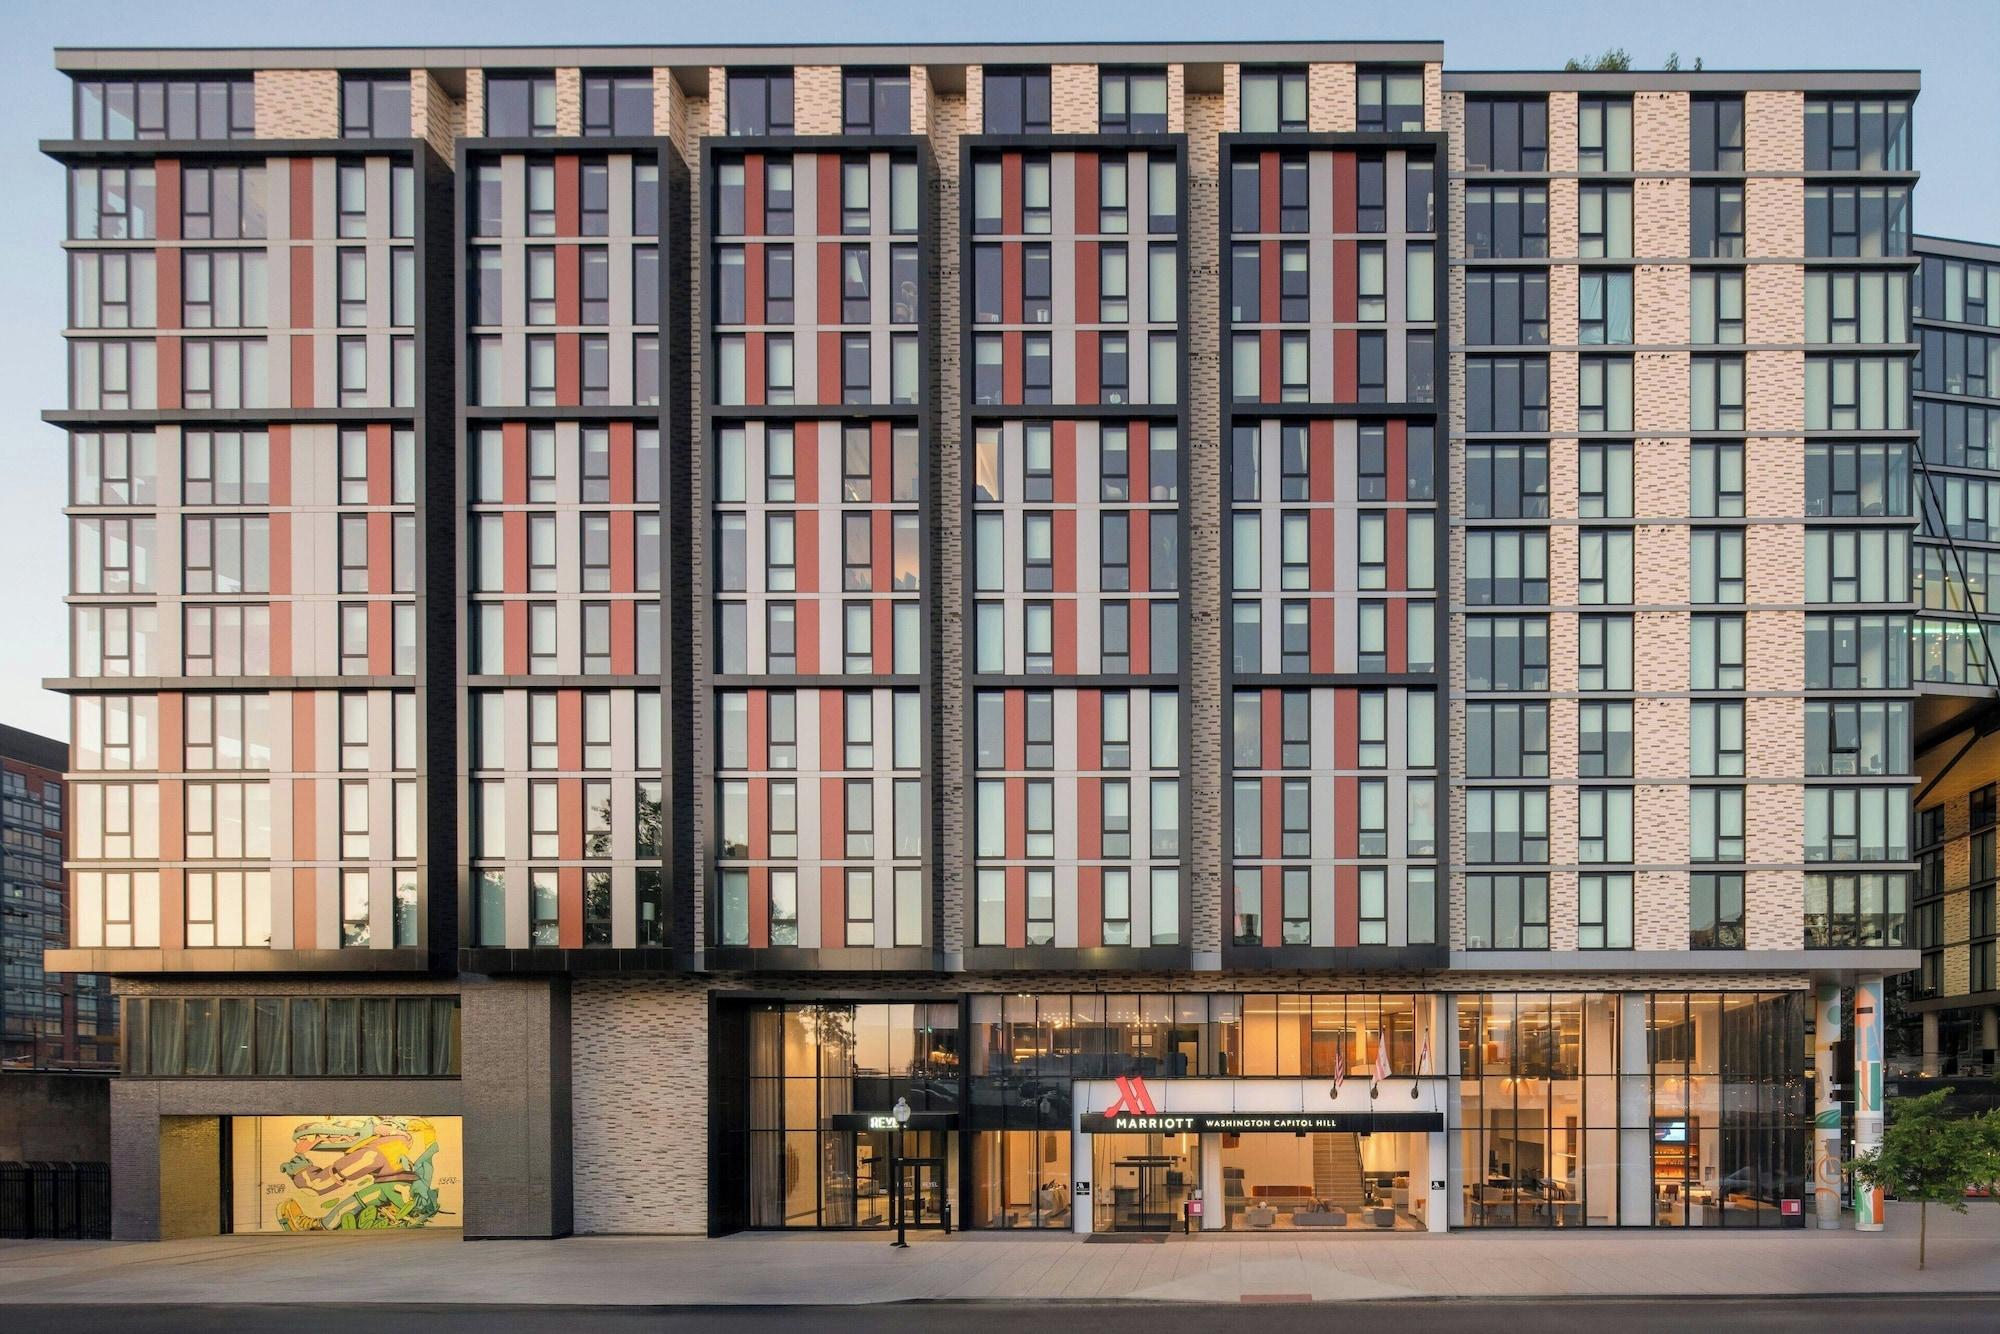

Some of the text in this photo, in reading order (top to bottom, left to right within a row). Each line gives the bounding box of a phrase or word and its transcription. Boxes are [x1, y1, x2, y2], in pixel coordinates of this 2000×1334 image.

[870, 1116, 907, 1129] REVE
[1116, 1118, 1337, 1129] MARRIOTT WASHINGTON CAPITOL HILL
